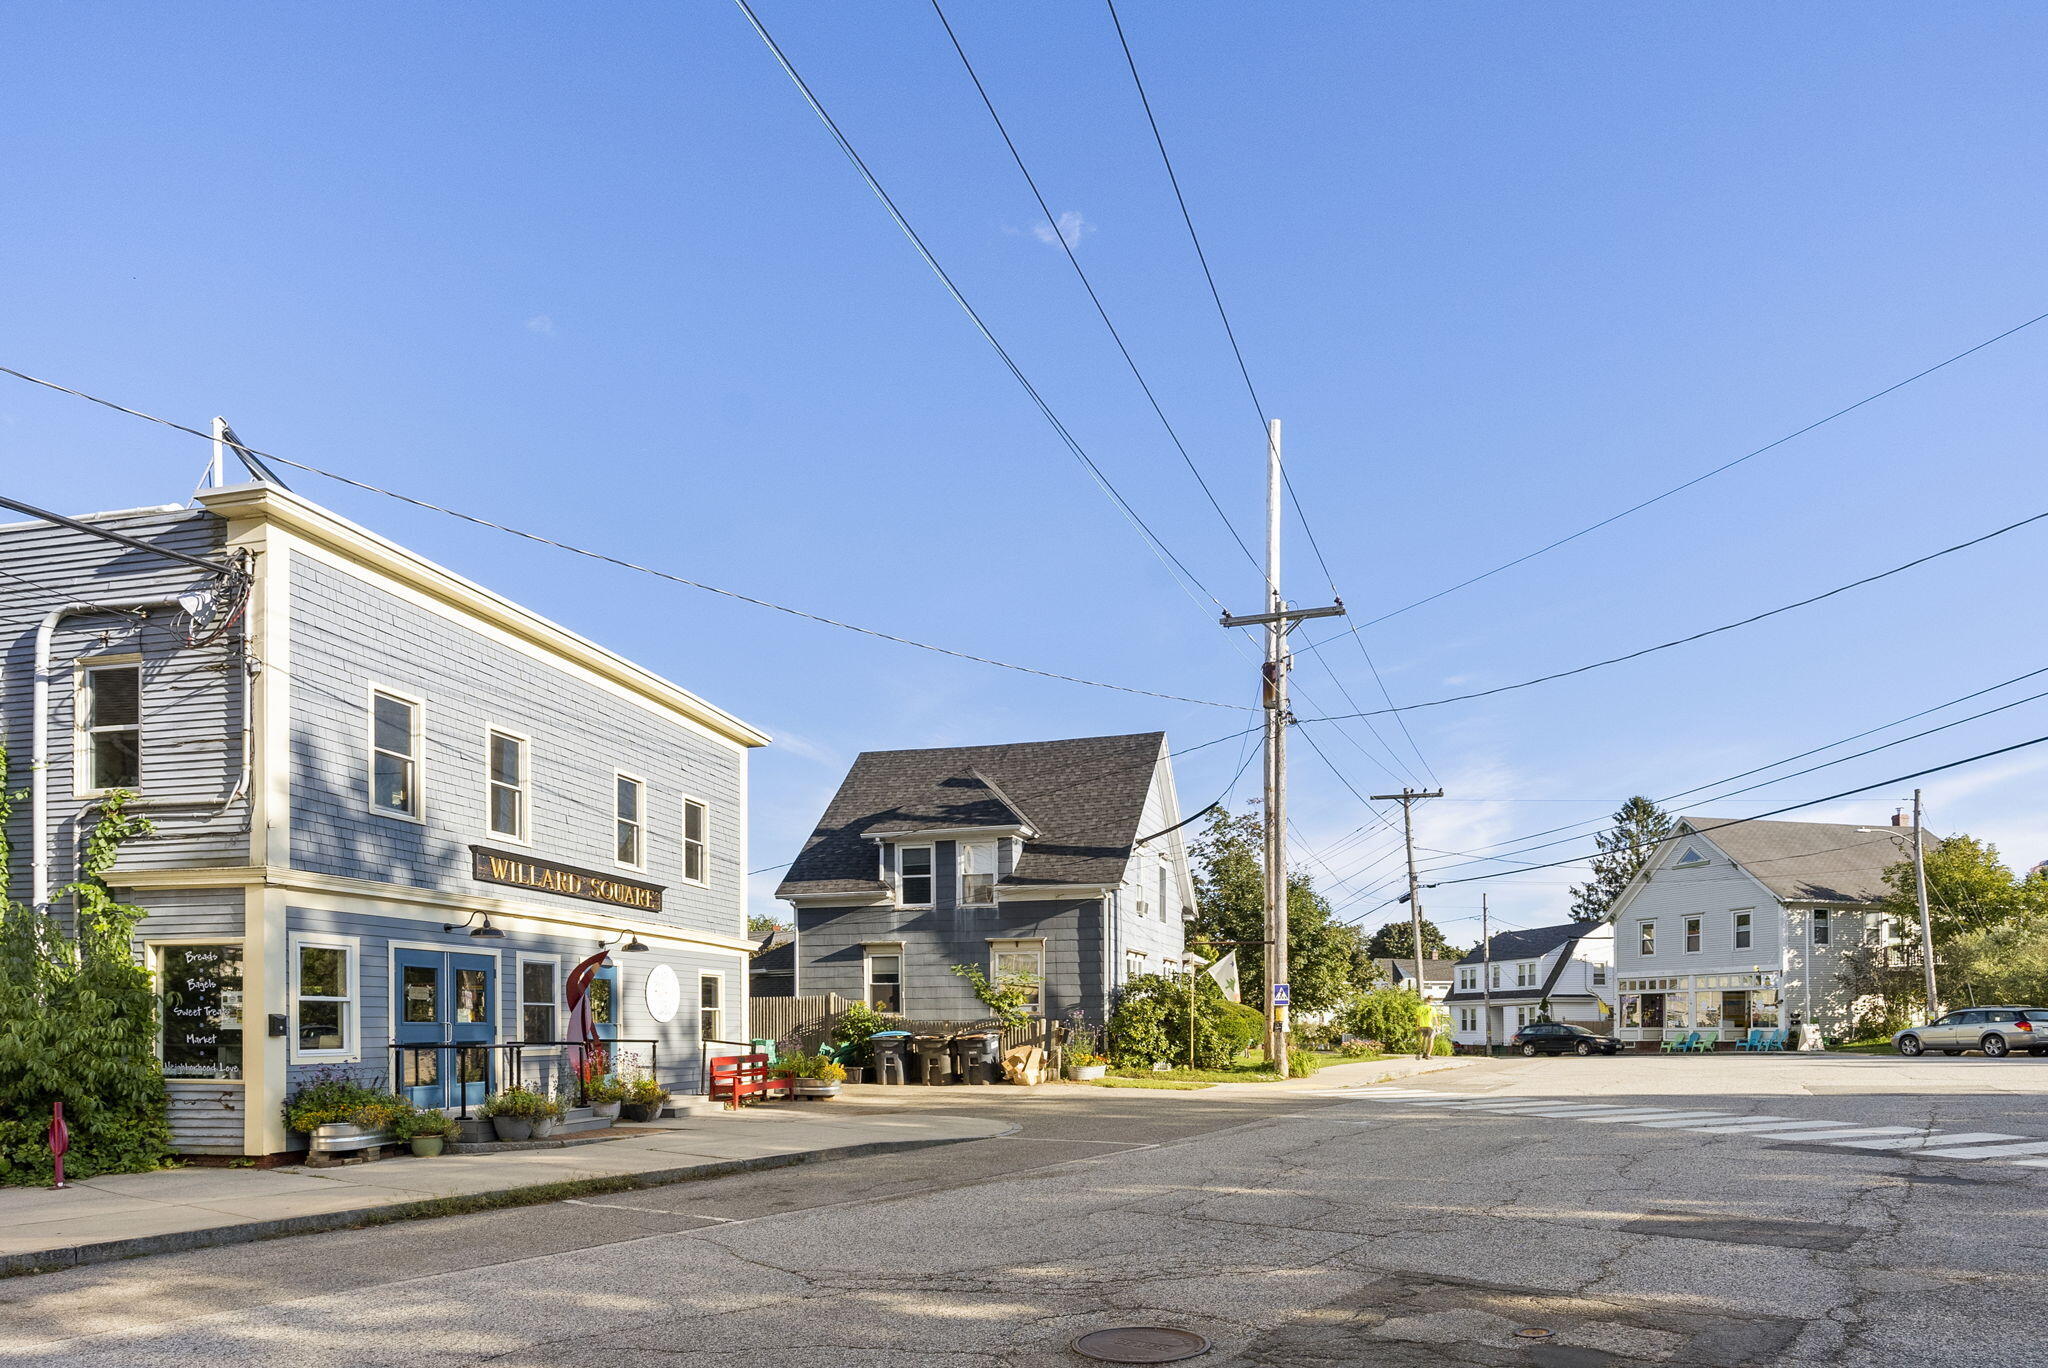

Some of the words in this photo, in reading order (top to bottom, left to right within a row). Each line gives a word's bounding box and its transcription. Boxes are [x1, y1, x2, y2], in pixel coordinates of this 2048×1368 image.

[489, 856, 582, 894] WILLARD
[590, 878, 656, 908] SQUARE
[185, 950, 218, 964] Breads
[186, 978, 217, 992] Bagels
[173, 1006, 202, 1017] Sweet
[204, 1005, 231, 1017] Treats
[186, 1033, 218, 1045] Market
[219, 1062, 239, 1073] Love
